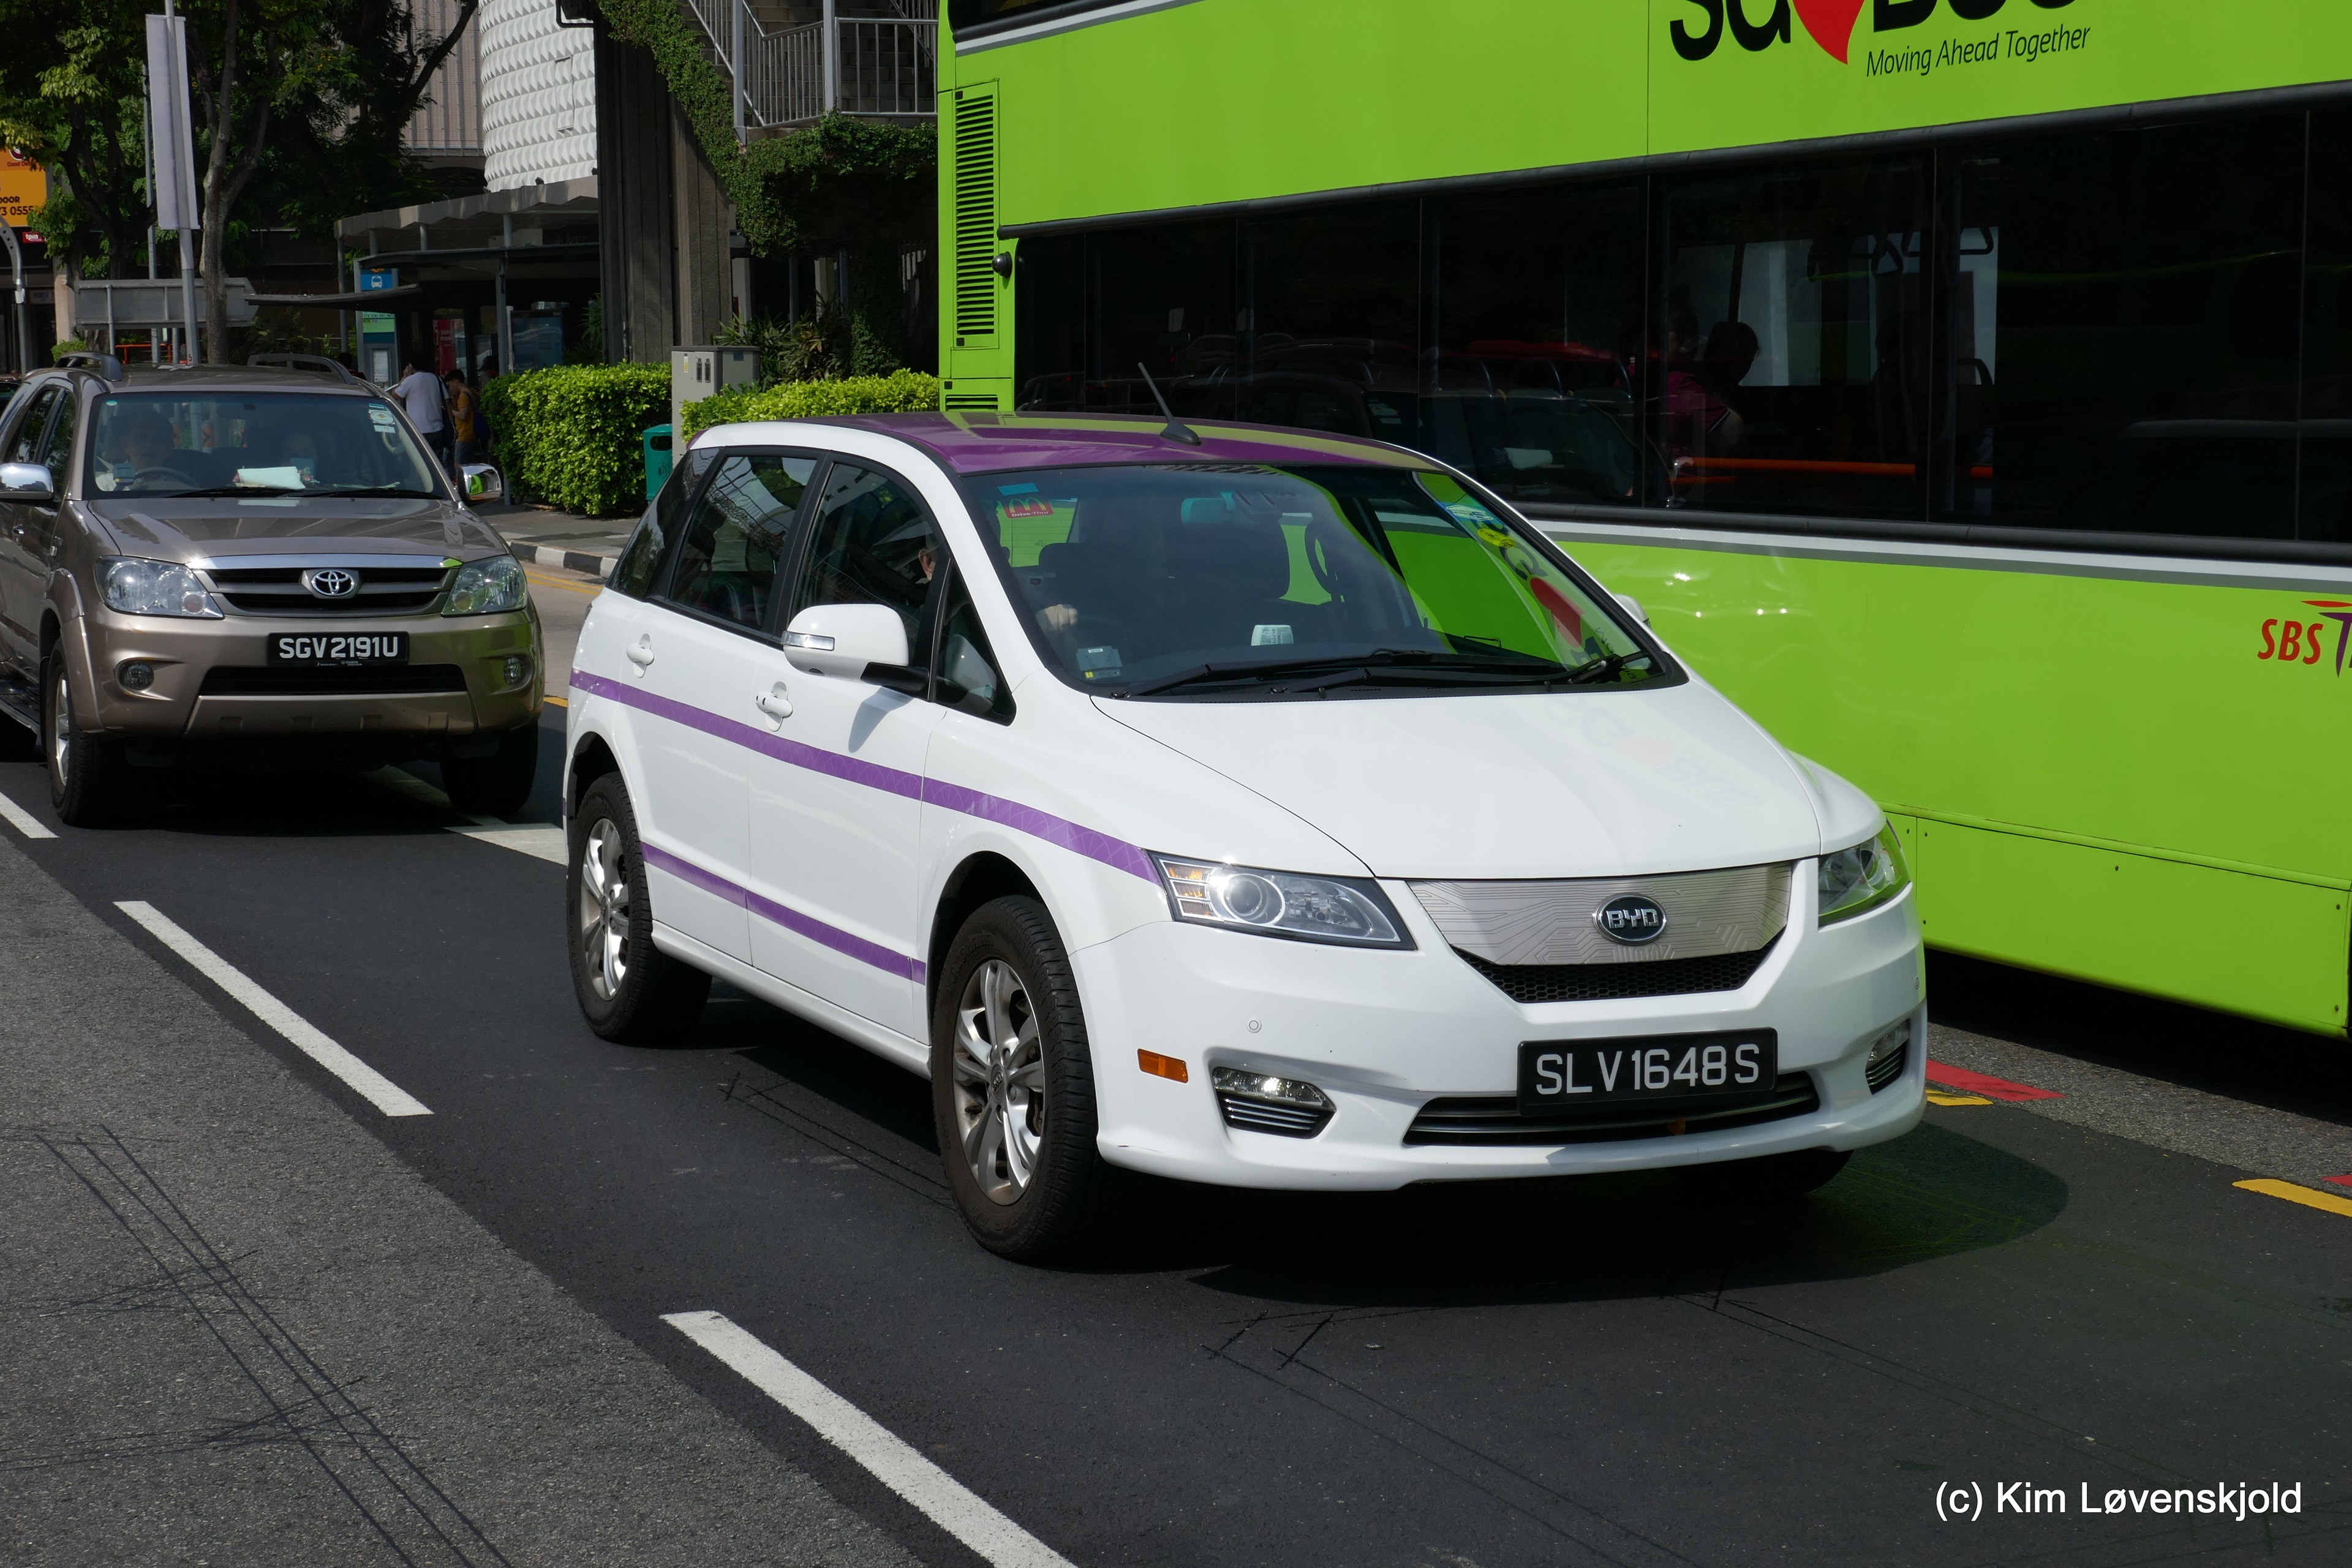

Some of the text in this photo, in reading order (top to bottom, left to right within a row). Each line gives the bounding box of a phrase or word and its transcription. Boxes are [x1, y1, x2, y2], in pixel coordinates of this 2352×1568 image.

[1866, 23, 2091, 77] Moving Ahead Together
[279, 636, 398, 659] SGV2191U
[2256, 618, 2324, 665] SBS
[1605, 908, 1660, 930] BYD
[1536, 1043, 1760, 1095] SLV1648S
